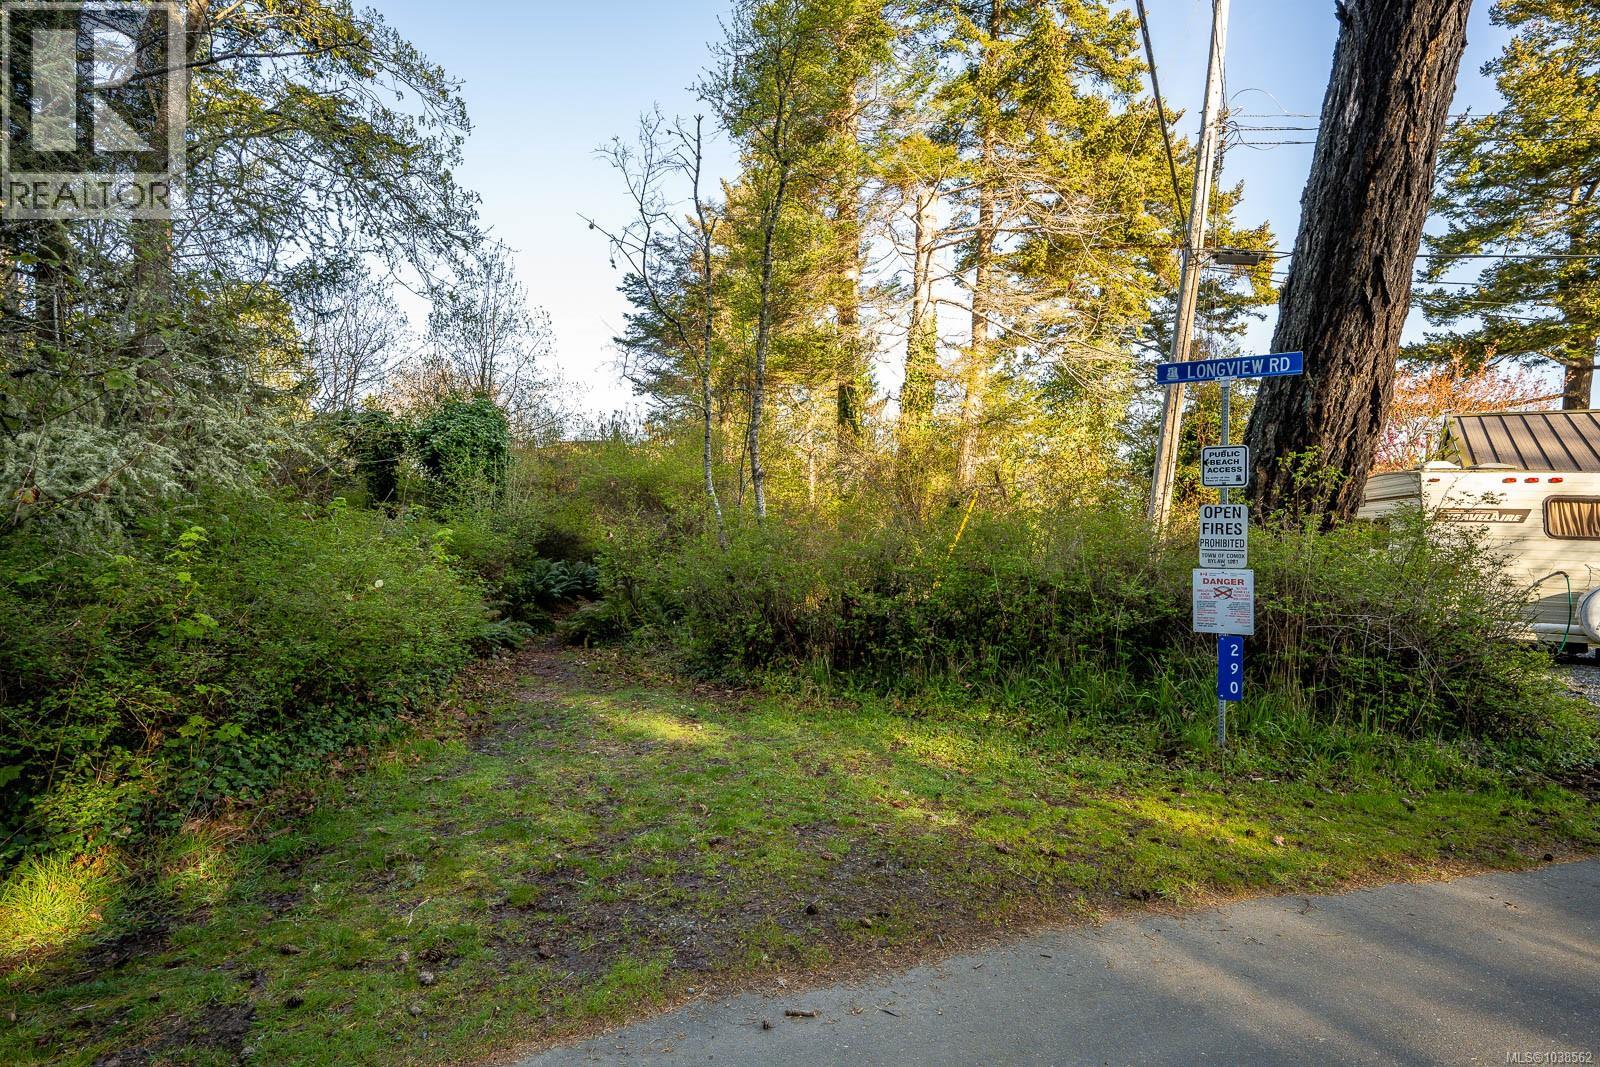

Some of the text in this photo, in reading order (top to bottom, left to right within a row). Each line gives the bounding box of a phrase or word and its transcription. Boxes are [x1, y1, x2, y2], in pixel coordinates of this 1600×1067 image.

[1187, 356, 1290, 379] LONGVIEW RD
[1204, 506, 1242, 519] OPEN
[1202, 522, 1242, 535] FIRES
[1200, 539, 1245, 548] PROHIBITED
